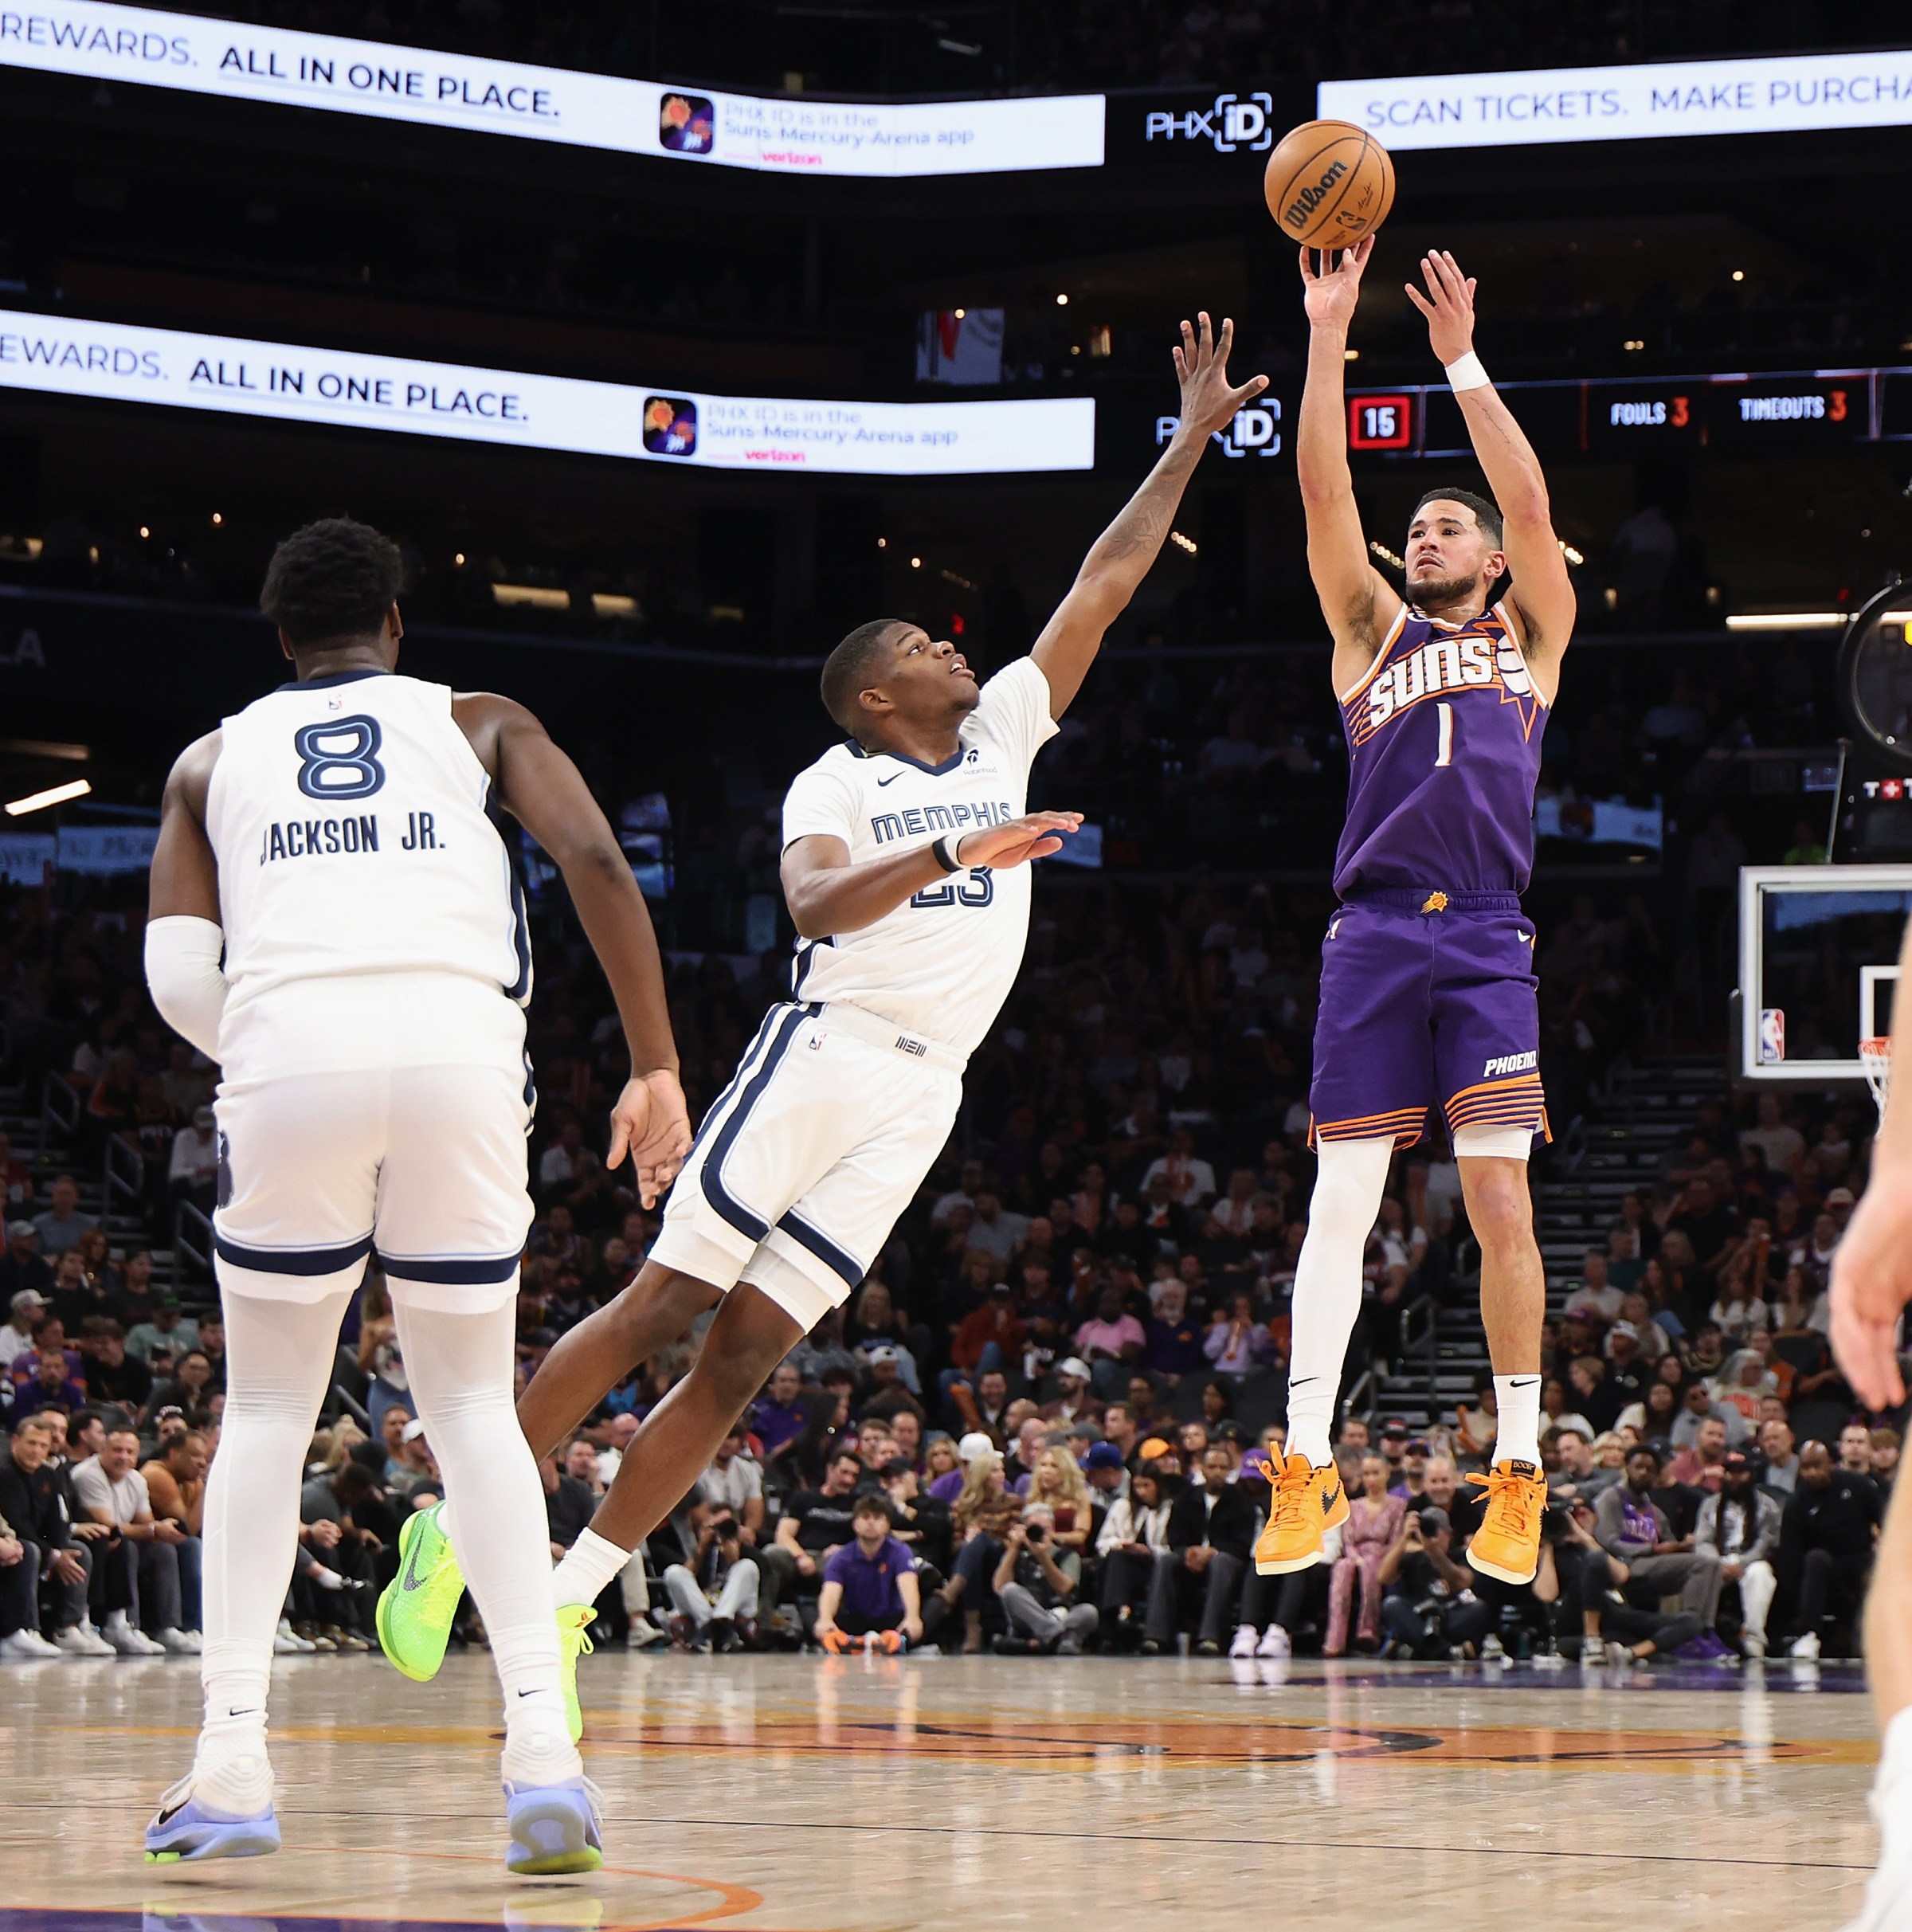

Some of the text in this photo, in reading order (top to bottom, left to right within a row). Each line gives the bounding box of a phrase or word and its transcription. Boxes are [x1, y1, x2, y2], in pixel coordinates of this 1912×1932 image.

[1, 12, 561, 116] REWARDS. ALL IN ONE PLACE.
[725, 100, 879, 127] PHX ID is in the
[1146, 109, 1215, 142] PHX
[1366, 97, 1462, 128] SCAN
[1475, 88, 1628, 120] TICKETS.
[1651, 80, 1755, 112] MAKE
[938, 129, 975, 146] app
[1284, 159, 1349, 229] Wilson
[190, 359, 257, 389] ALL
[269, 366, 304, 394] IN
[317, 373, 393, 405] ONE
[406, 382, 530, 421] PLACE.
[1610, 396, 1690, 428] FOULS 3
[1738, 390, 1847, 421] TIMEOUTS 3
[707, 402, 861, 425] PHX ID is in the
[1364, 406, 1396, 438] 15
[922, 429, 959, 447] app
[1369, 637, 1495, 728] SUNS
[1434, 702, 1454, 767] 1
[295, 714, 386, 800] 8
[261, 811, 447, 867] JACKSON JR.
[871, 801, 1012, 845] MEMPHIS
